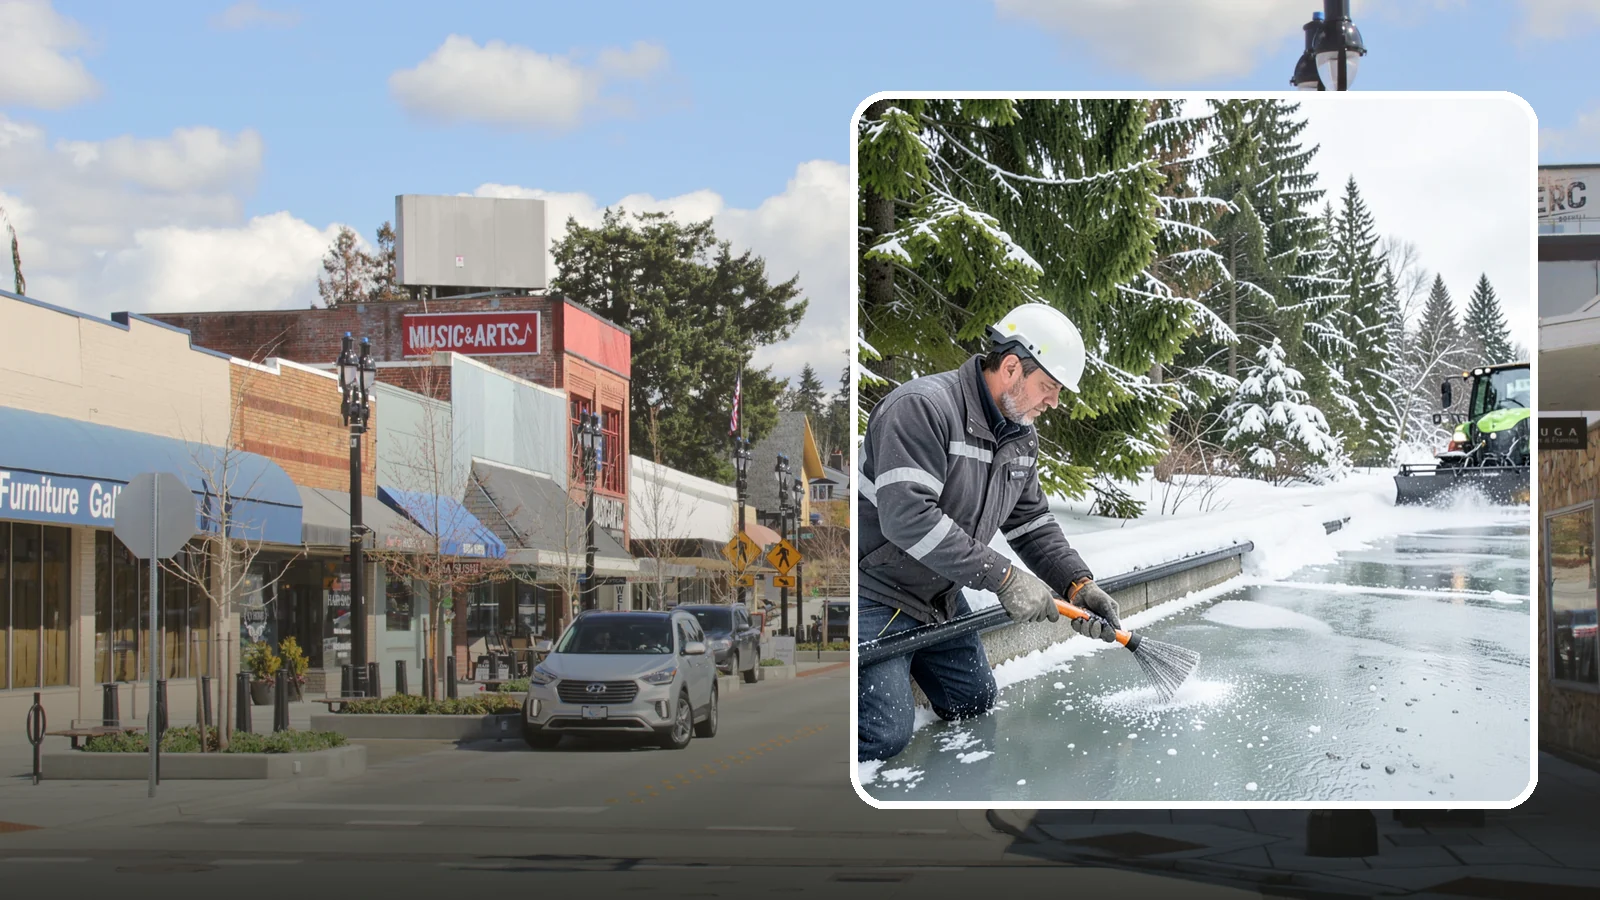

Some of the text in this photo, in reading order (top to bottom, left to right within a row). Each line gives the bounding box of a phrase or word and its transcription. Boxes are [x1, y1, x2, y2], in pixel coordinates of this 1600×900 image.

[408, 322, 520, 349] MUSIC&ARTS
[0, 471, 122, 520] Furniture Gal
